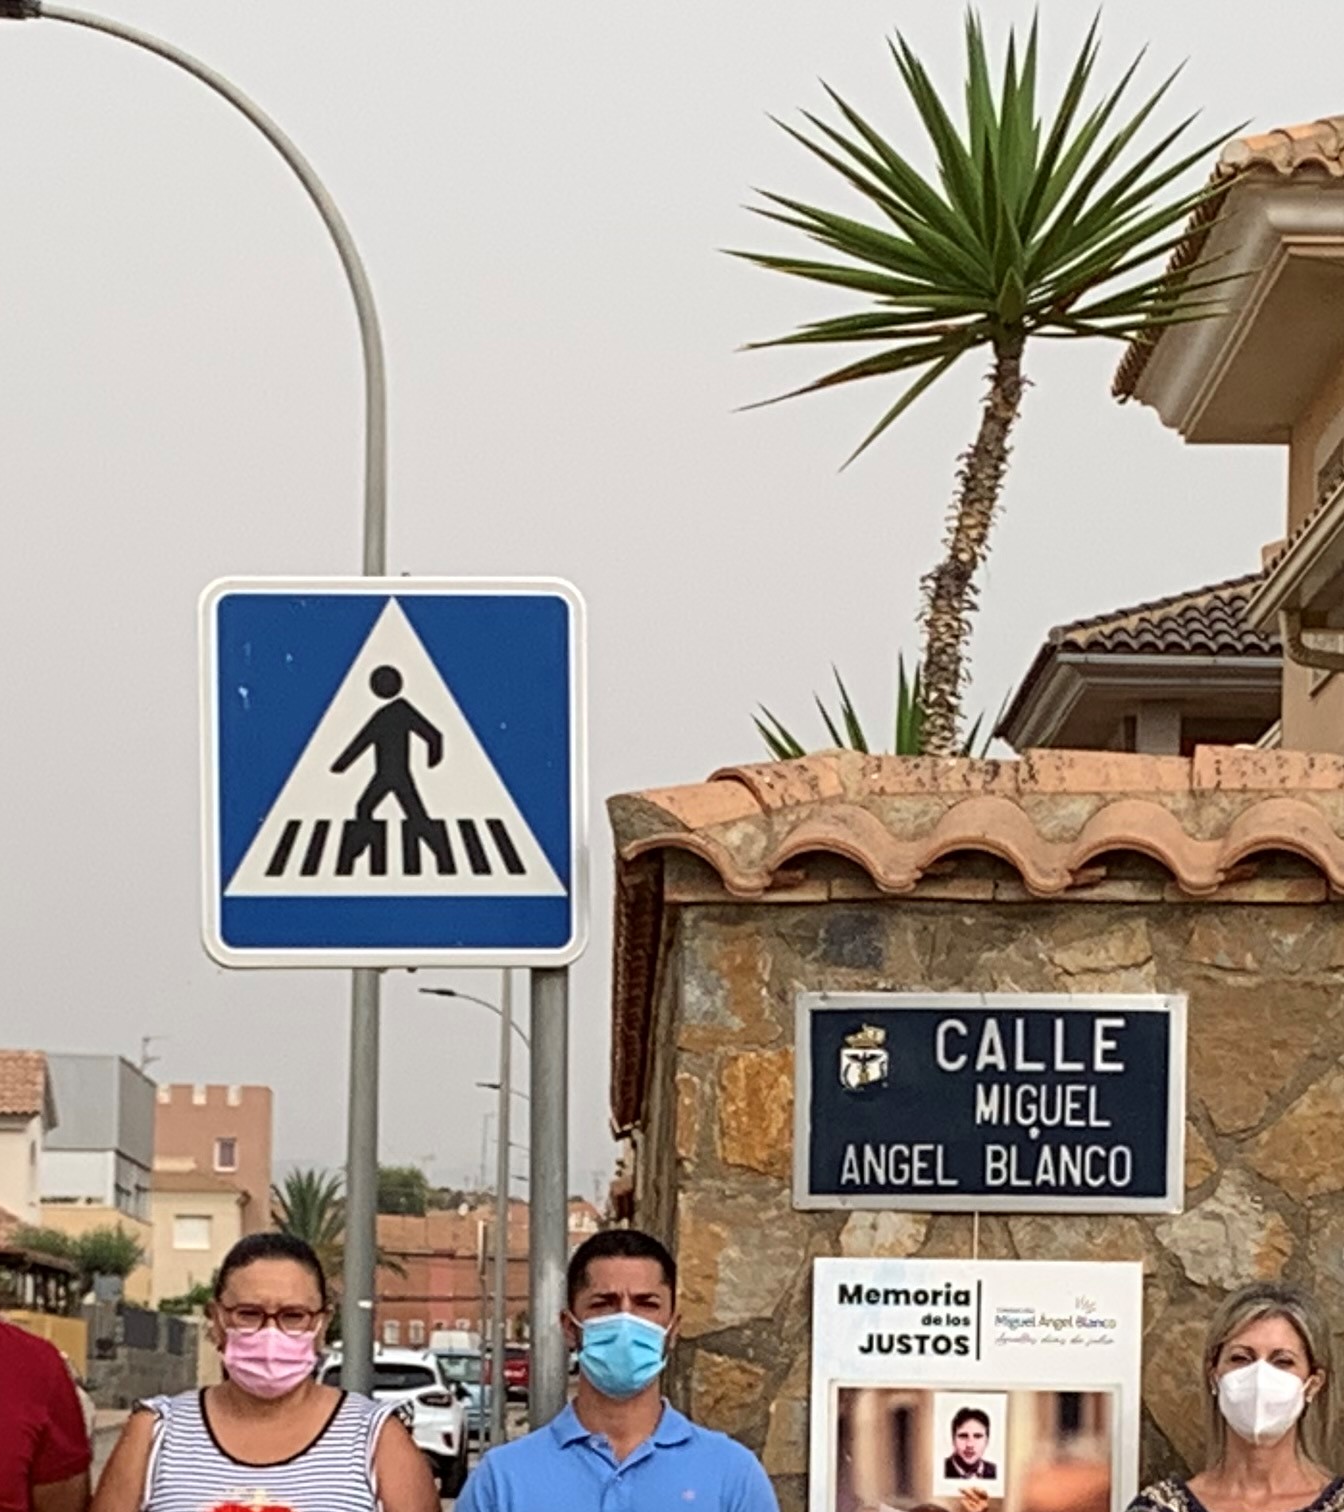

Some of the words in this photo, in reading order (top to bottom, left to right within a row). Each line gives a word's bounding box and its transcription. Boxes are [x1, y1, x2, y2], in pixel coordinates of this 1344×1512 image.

[935, 1018, 1126, 1072] CALLE
[975, 1083, 1111, 1127] MIGUEL
[840, 1144, 958, 1187] ANGEL
[985, 1144, 1132, 1188] BLANCO
[838, 1282, 971, 1306] Memoria
[921, 1313, 942, 1326] de
[945, 1313, 971, 1326] los
[994, 1314, 1036, 1331] Miguel
[1075, 1315, 1117, 1330] Blanco
[858, 1333, 970, 1356] JUSTOS
